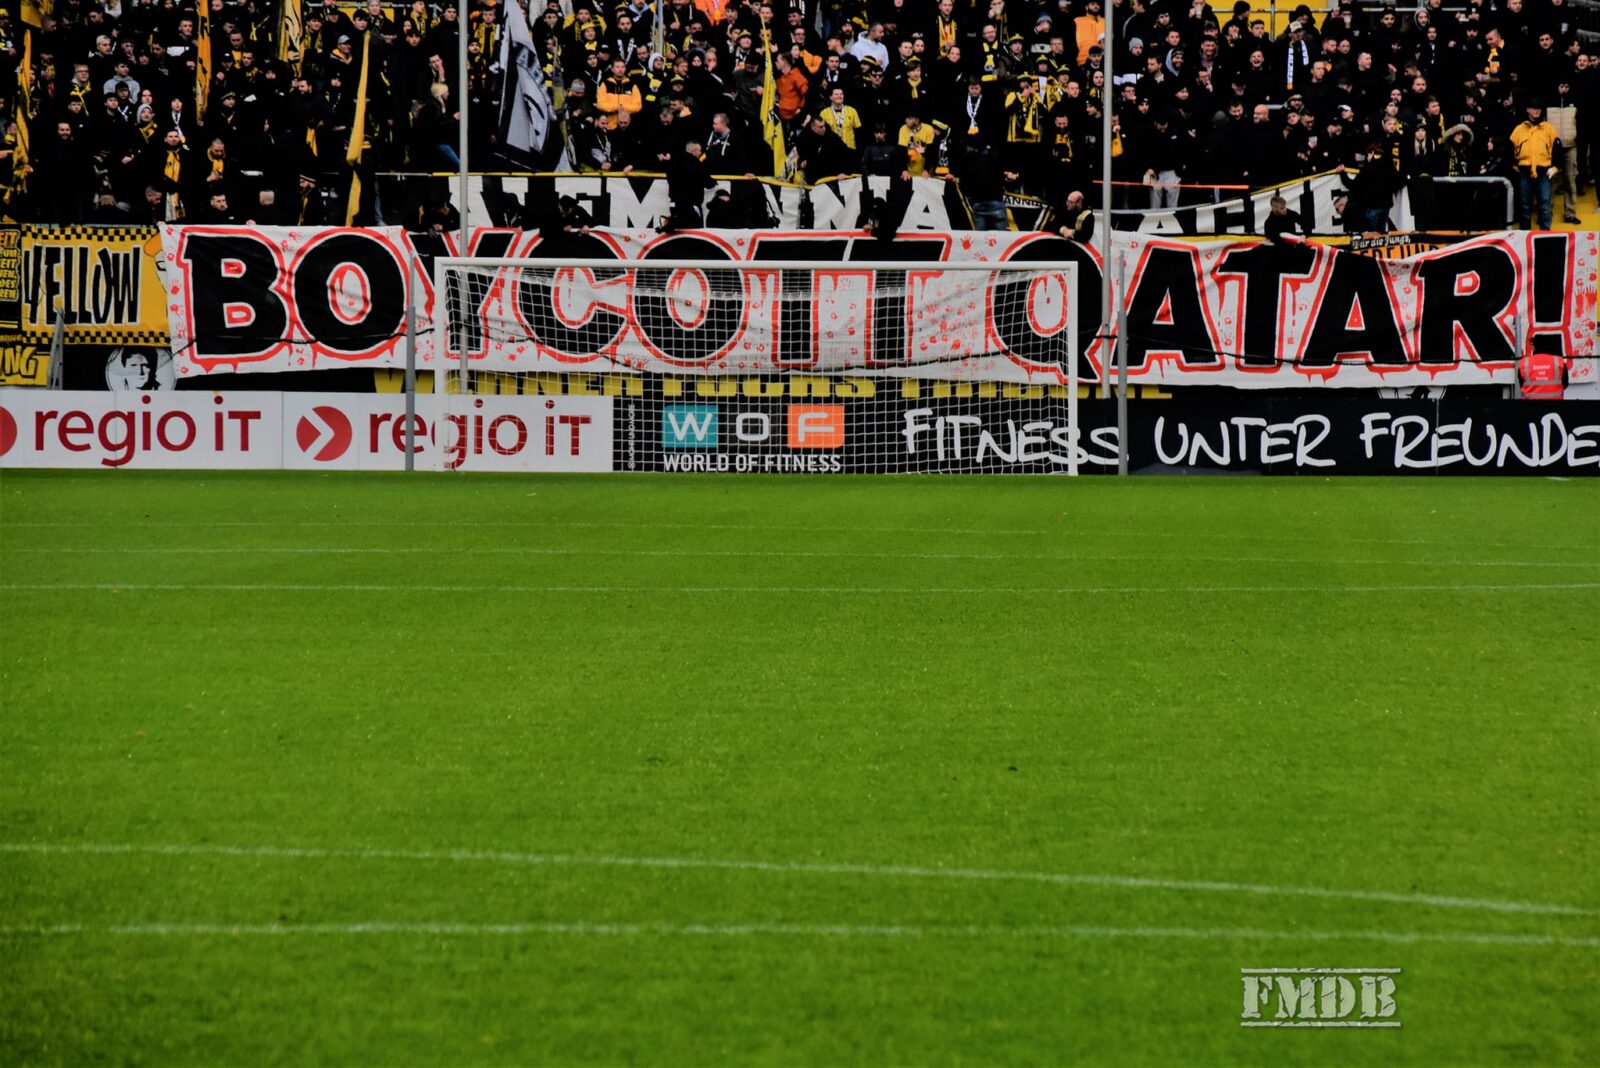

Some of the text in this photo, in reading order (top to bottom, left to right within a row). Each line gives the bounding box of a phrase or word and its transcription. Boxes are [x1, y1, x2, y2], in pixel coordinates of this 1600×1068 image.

[24, 244, 140, 325] YELLOW
[180, 227, 950, 368] BOYCOTT
[988, 230, 1573, 380] QATAR!
[34, 395, 262, 466] regio iT
[369, 397, 592, 469] regio iT
[663, 454, 842, 472] WORLD OF FITNESS
[901, 407, 1600, 469] FITNESS UNTER FREUNDE
